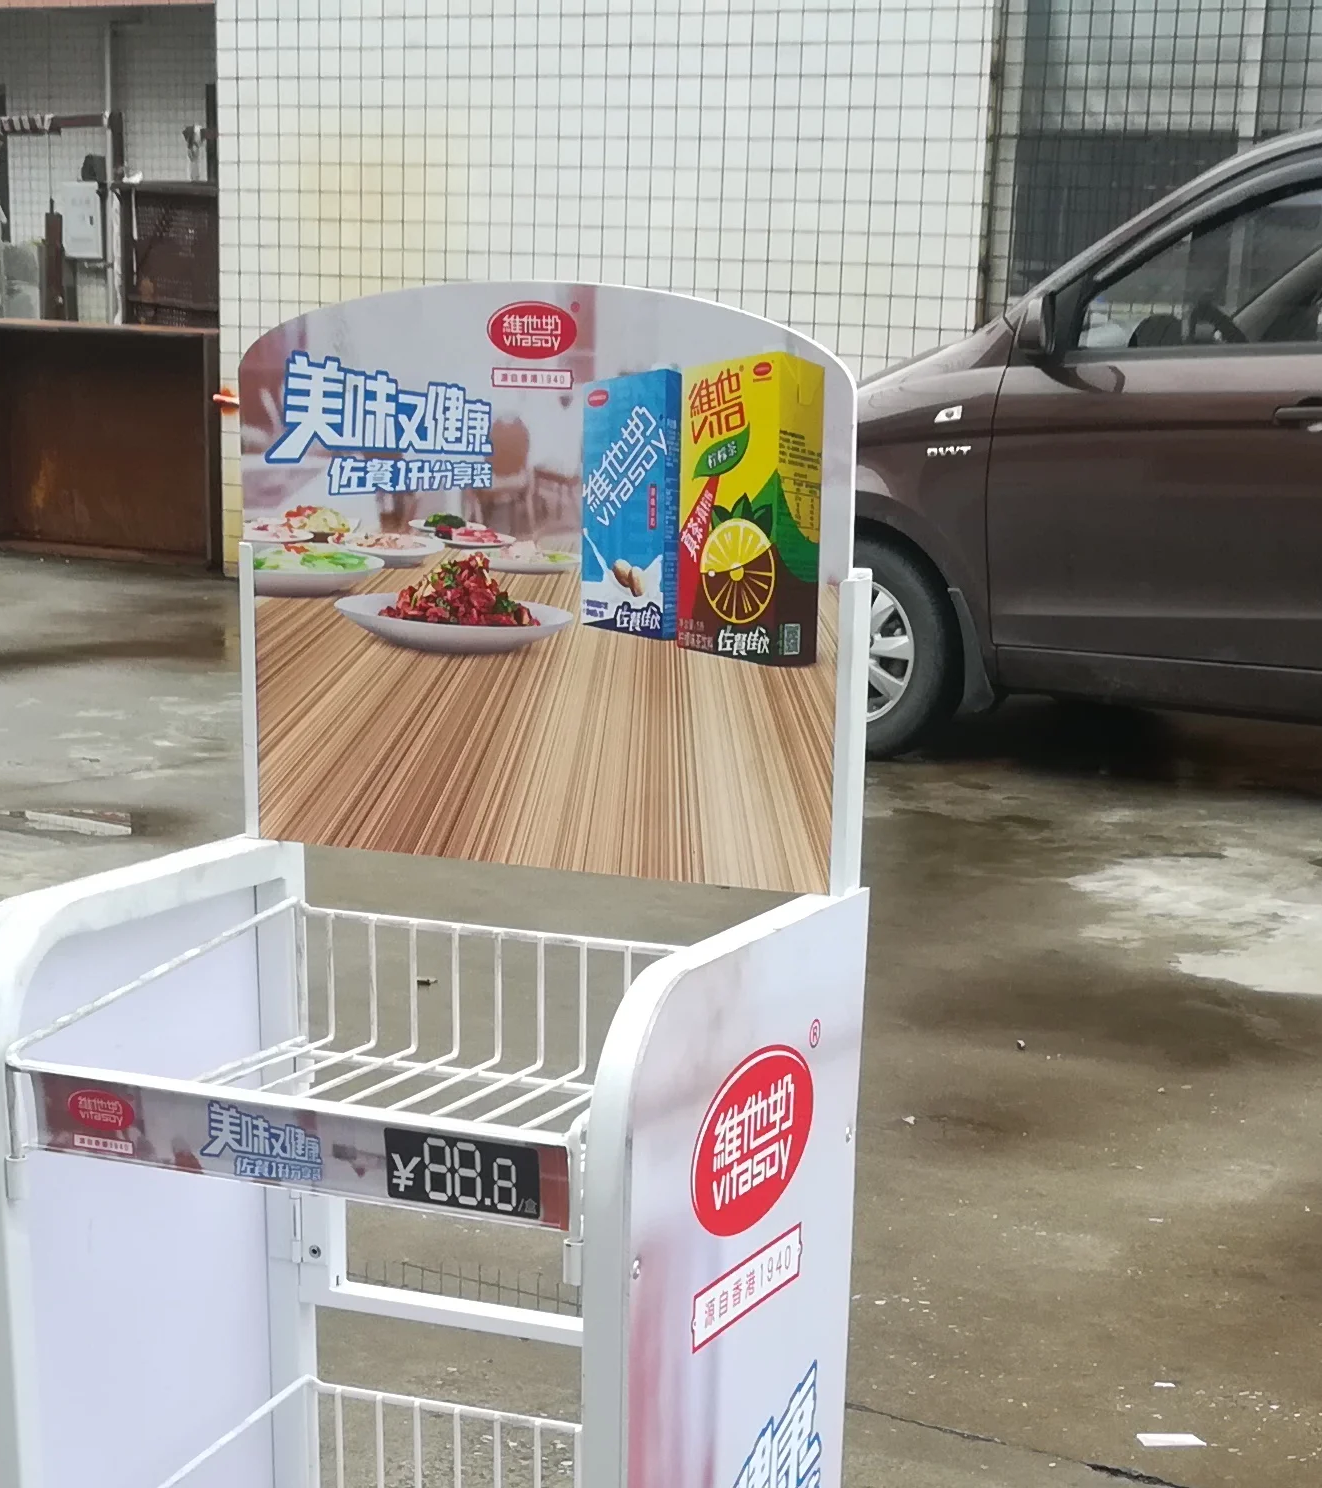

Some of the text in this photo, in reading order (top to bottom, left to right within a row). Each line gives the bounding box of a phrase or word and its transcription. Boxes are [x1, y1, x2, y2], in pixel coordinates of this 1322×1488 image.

[502, 334, 561, 351] vitasoy
[265, 352, 494, 462] 美味又健康
[328, 456, 493, 496] 佐餐1升分享装
[596, 428, 667, 526] vitasoy
[78, 1109, 124, 1127] vitasoy
[200, 1100, 322, 1158] 美味又健康
[711, 1134, 794, 1211] vitasoy
[704, 1243, 793, 1329] 源自香港1940
